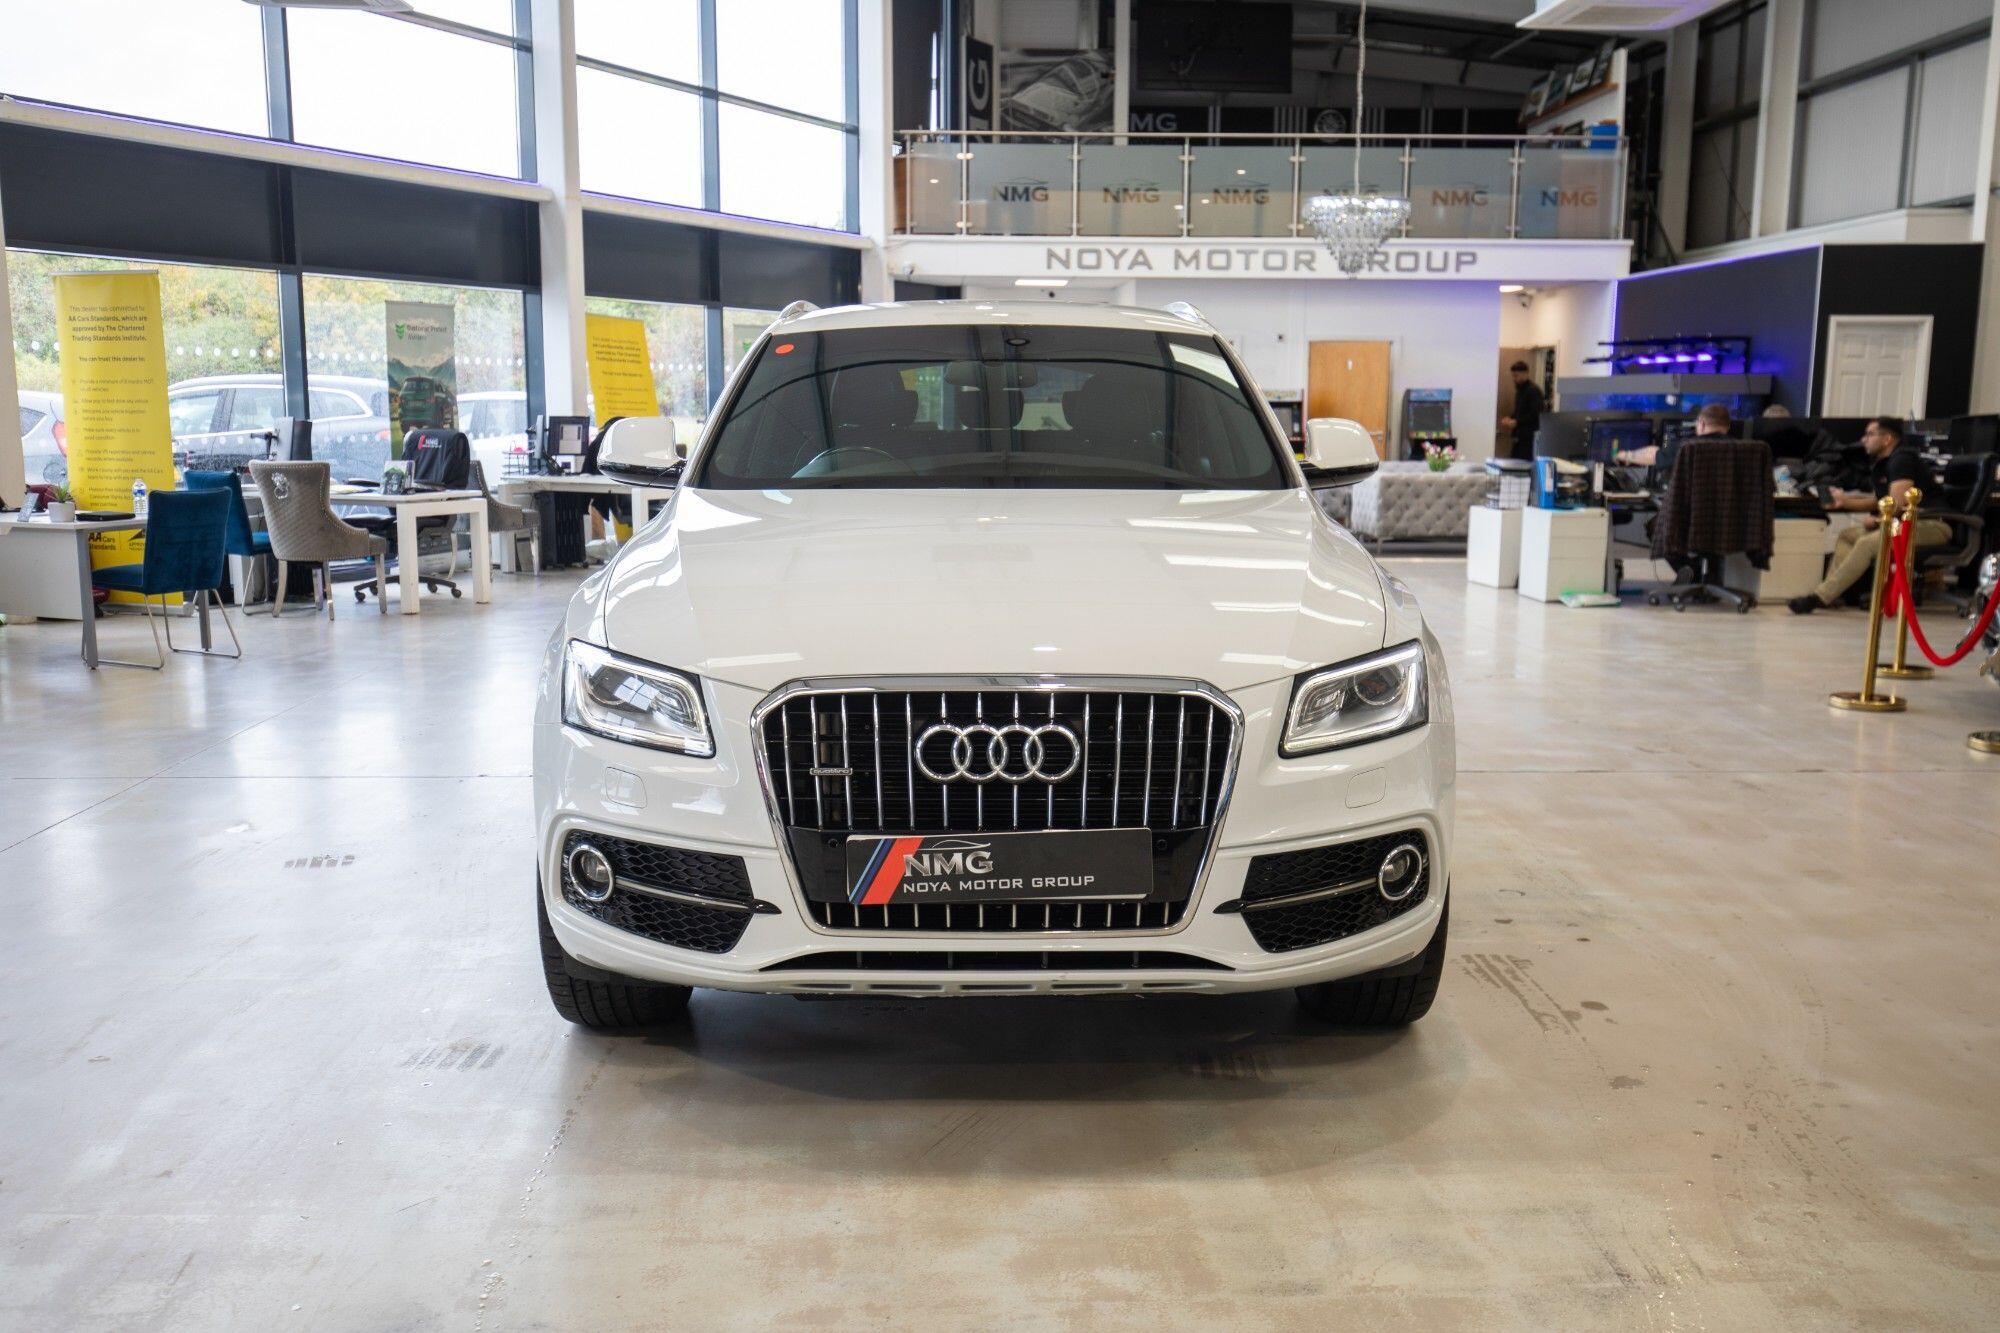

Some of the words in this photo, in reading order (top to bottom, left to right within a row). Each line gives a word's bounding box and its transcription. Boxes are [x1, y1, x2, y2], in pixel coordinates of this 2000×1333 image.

[1130, 112, 1178, 132] MG
[994, 186, 1049, 202] NMG
[1103, 188, 1159, 203] NMG
[1213, 188, 1270, 204] NMG
[1432, 190, 1488, 206] NMG
[1541, 190, 1597, 206] NMG
[1047, 248, 1152, 271] NOYA
[1174, 249, 1316, 272] MOTOR
[1339, 250, 1477, 272] ROUP
[903, 851, 993, 877] NMG
[903, 882, 951, 893] NOYA
[959, 878, 1024, 891] MOTOR
[1031, 875, 1095, 888] GROUP
